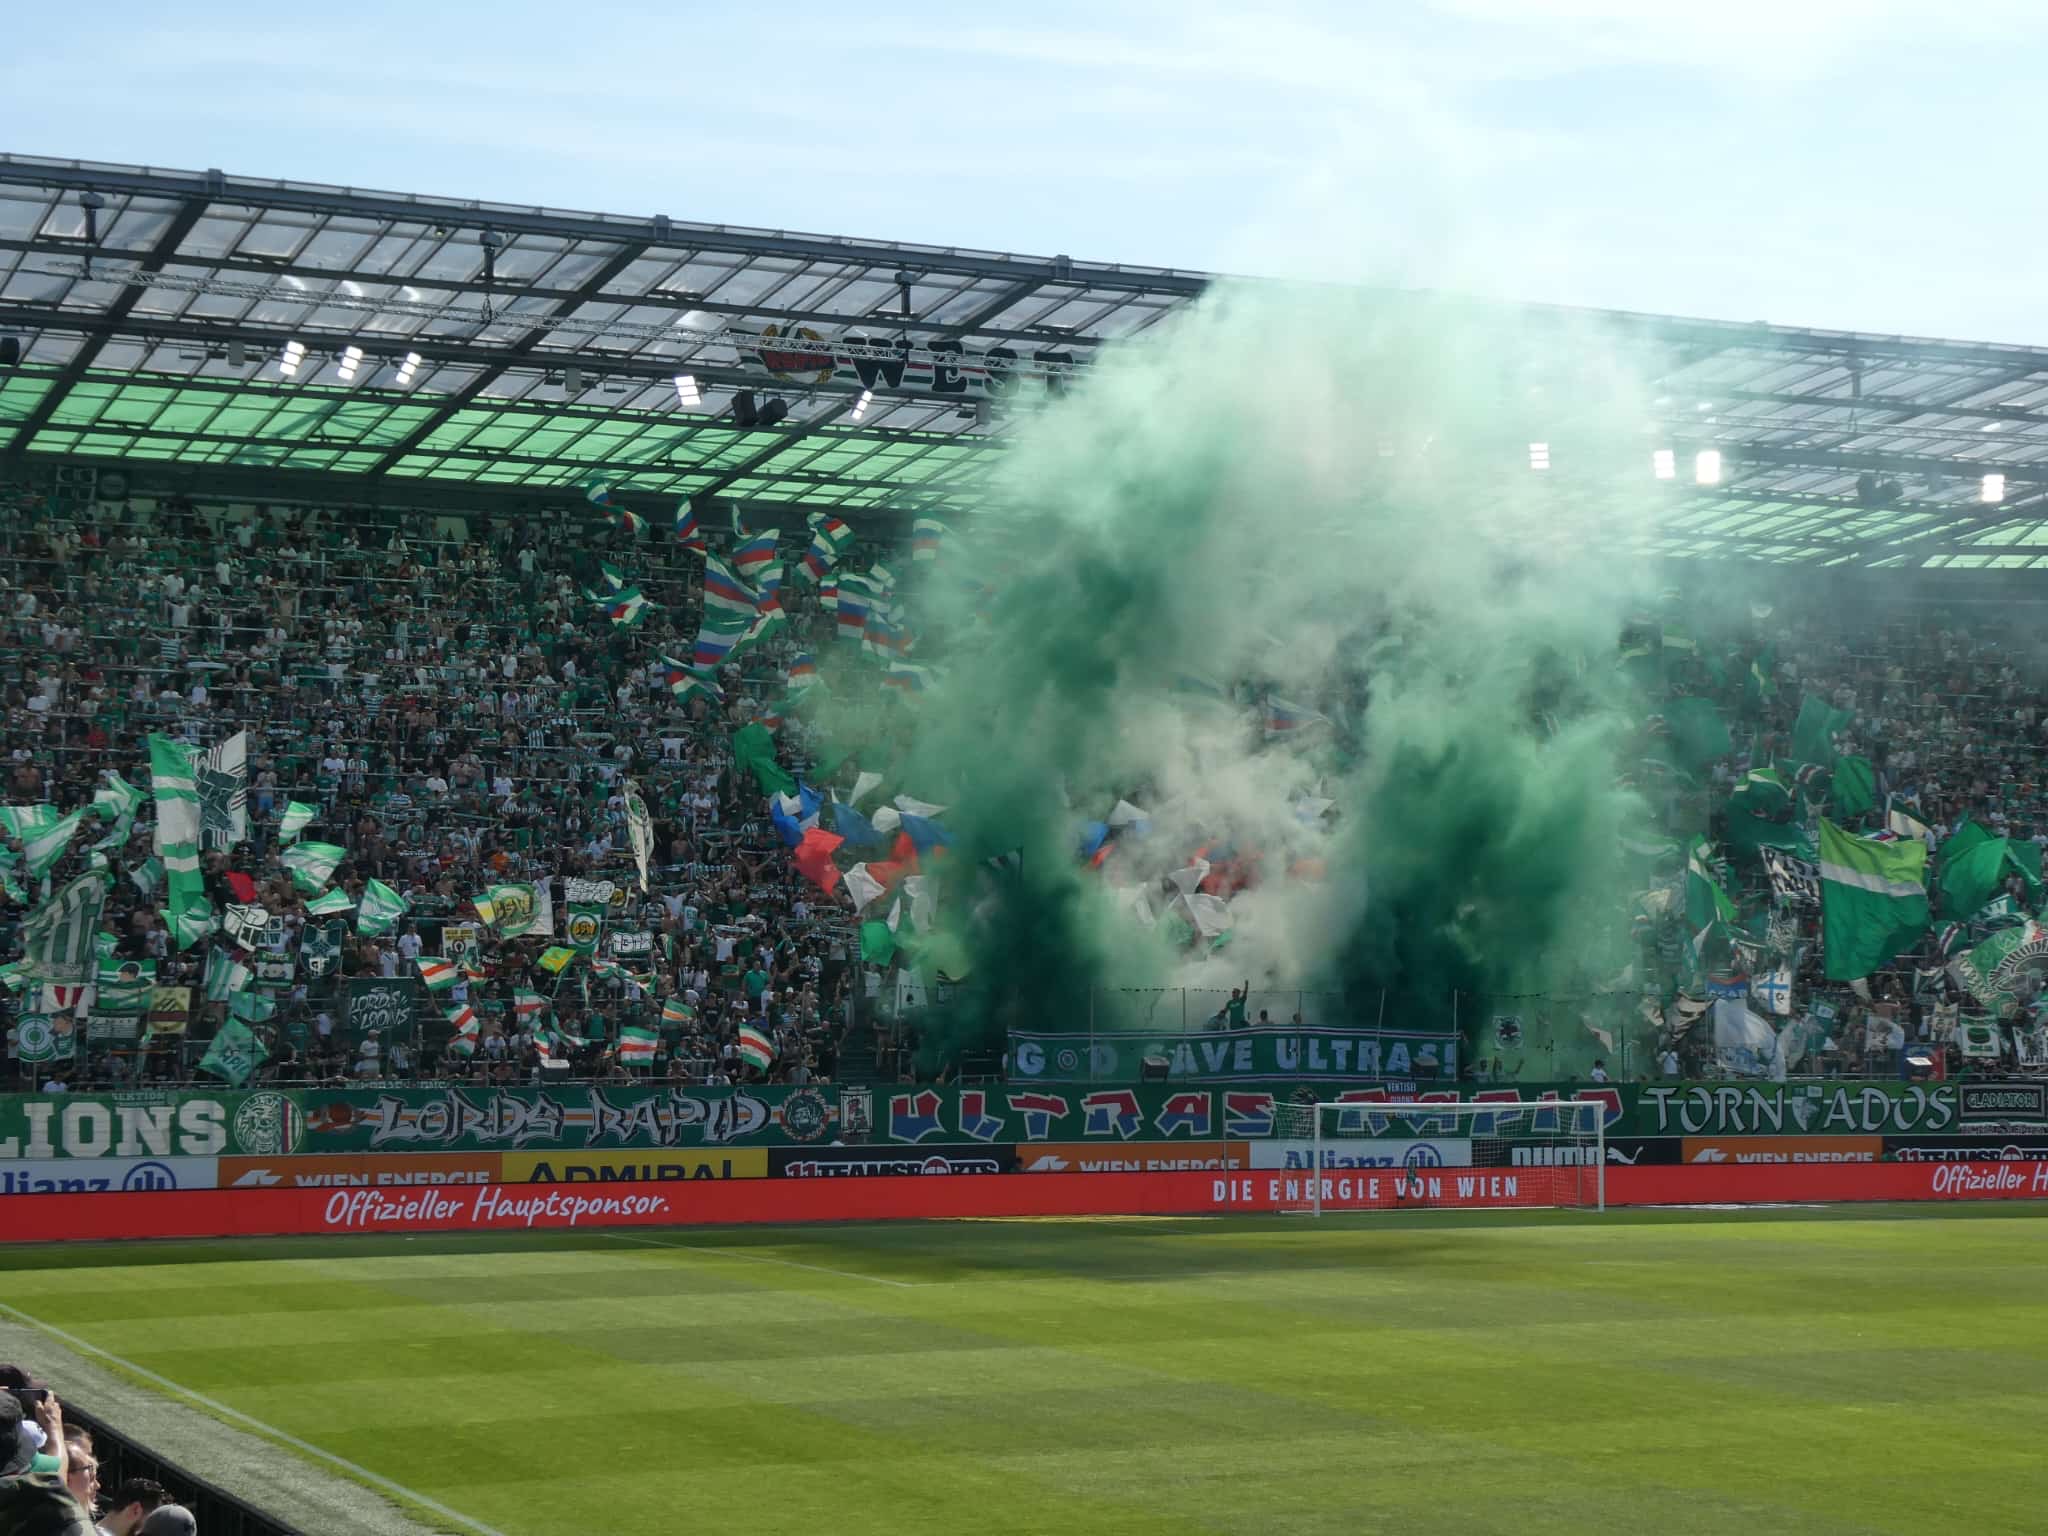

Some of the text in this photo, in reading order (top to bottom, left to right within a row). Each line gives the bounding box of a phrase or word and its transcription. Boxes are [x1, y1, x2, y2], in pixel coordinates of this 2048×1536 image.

[371, 1089, 566, 1147] LORDS
[587, 1086, 772, 1147] RAPID
[889, 1089, 1275, 1143] ULTRAS
[1212, 1174, 1519, 1202] DIE ENERGIE VON WIEN
[1932, 1164, 2027, 1194] Offizieller
[324, 1184, 671, 1226] Offizieller Hauptsponsor.
